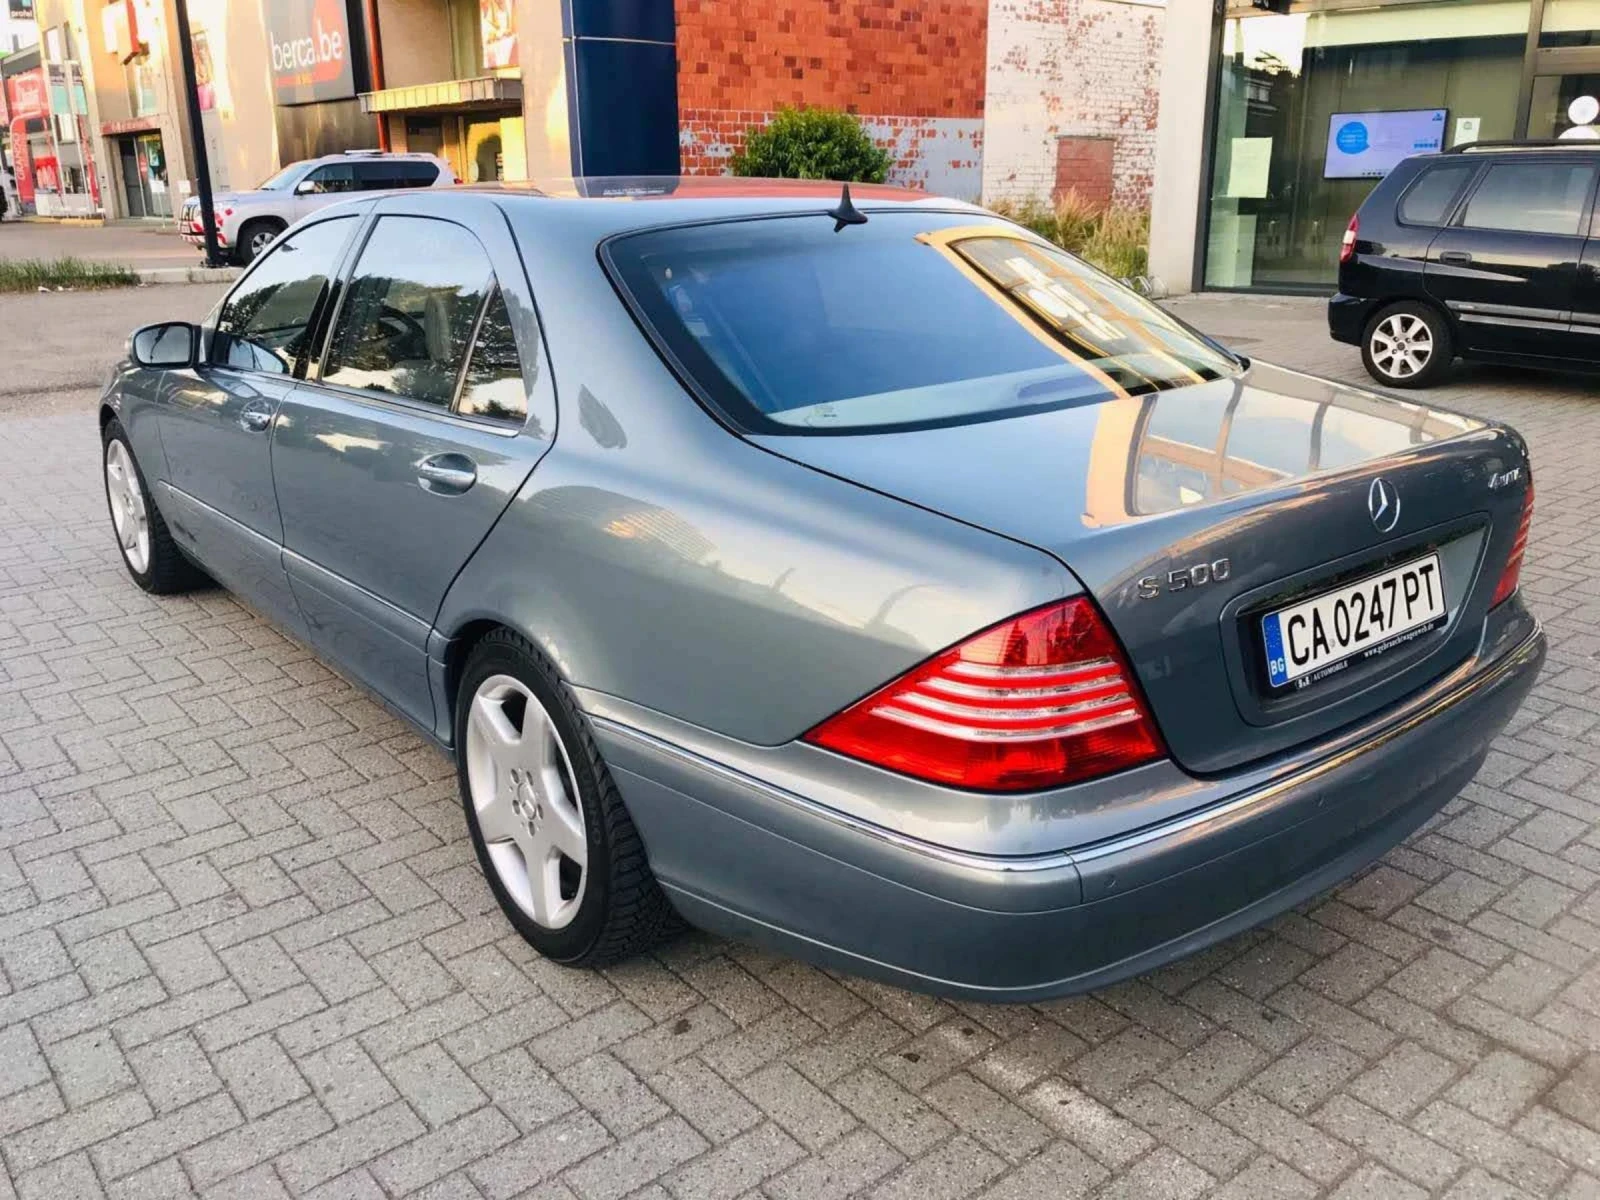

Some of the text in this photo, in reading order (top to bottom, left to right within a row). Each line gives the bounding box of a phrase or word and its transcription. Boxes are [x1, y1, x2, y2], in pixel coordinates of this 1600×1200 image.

[270, 18, 343, 71] berca.be
[1138, 558, 1231, 599] S 500
[1270, 657, 1286, 676] BG
